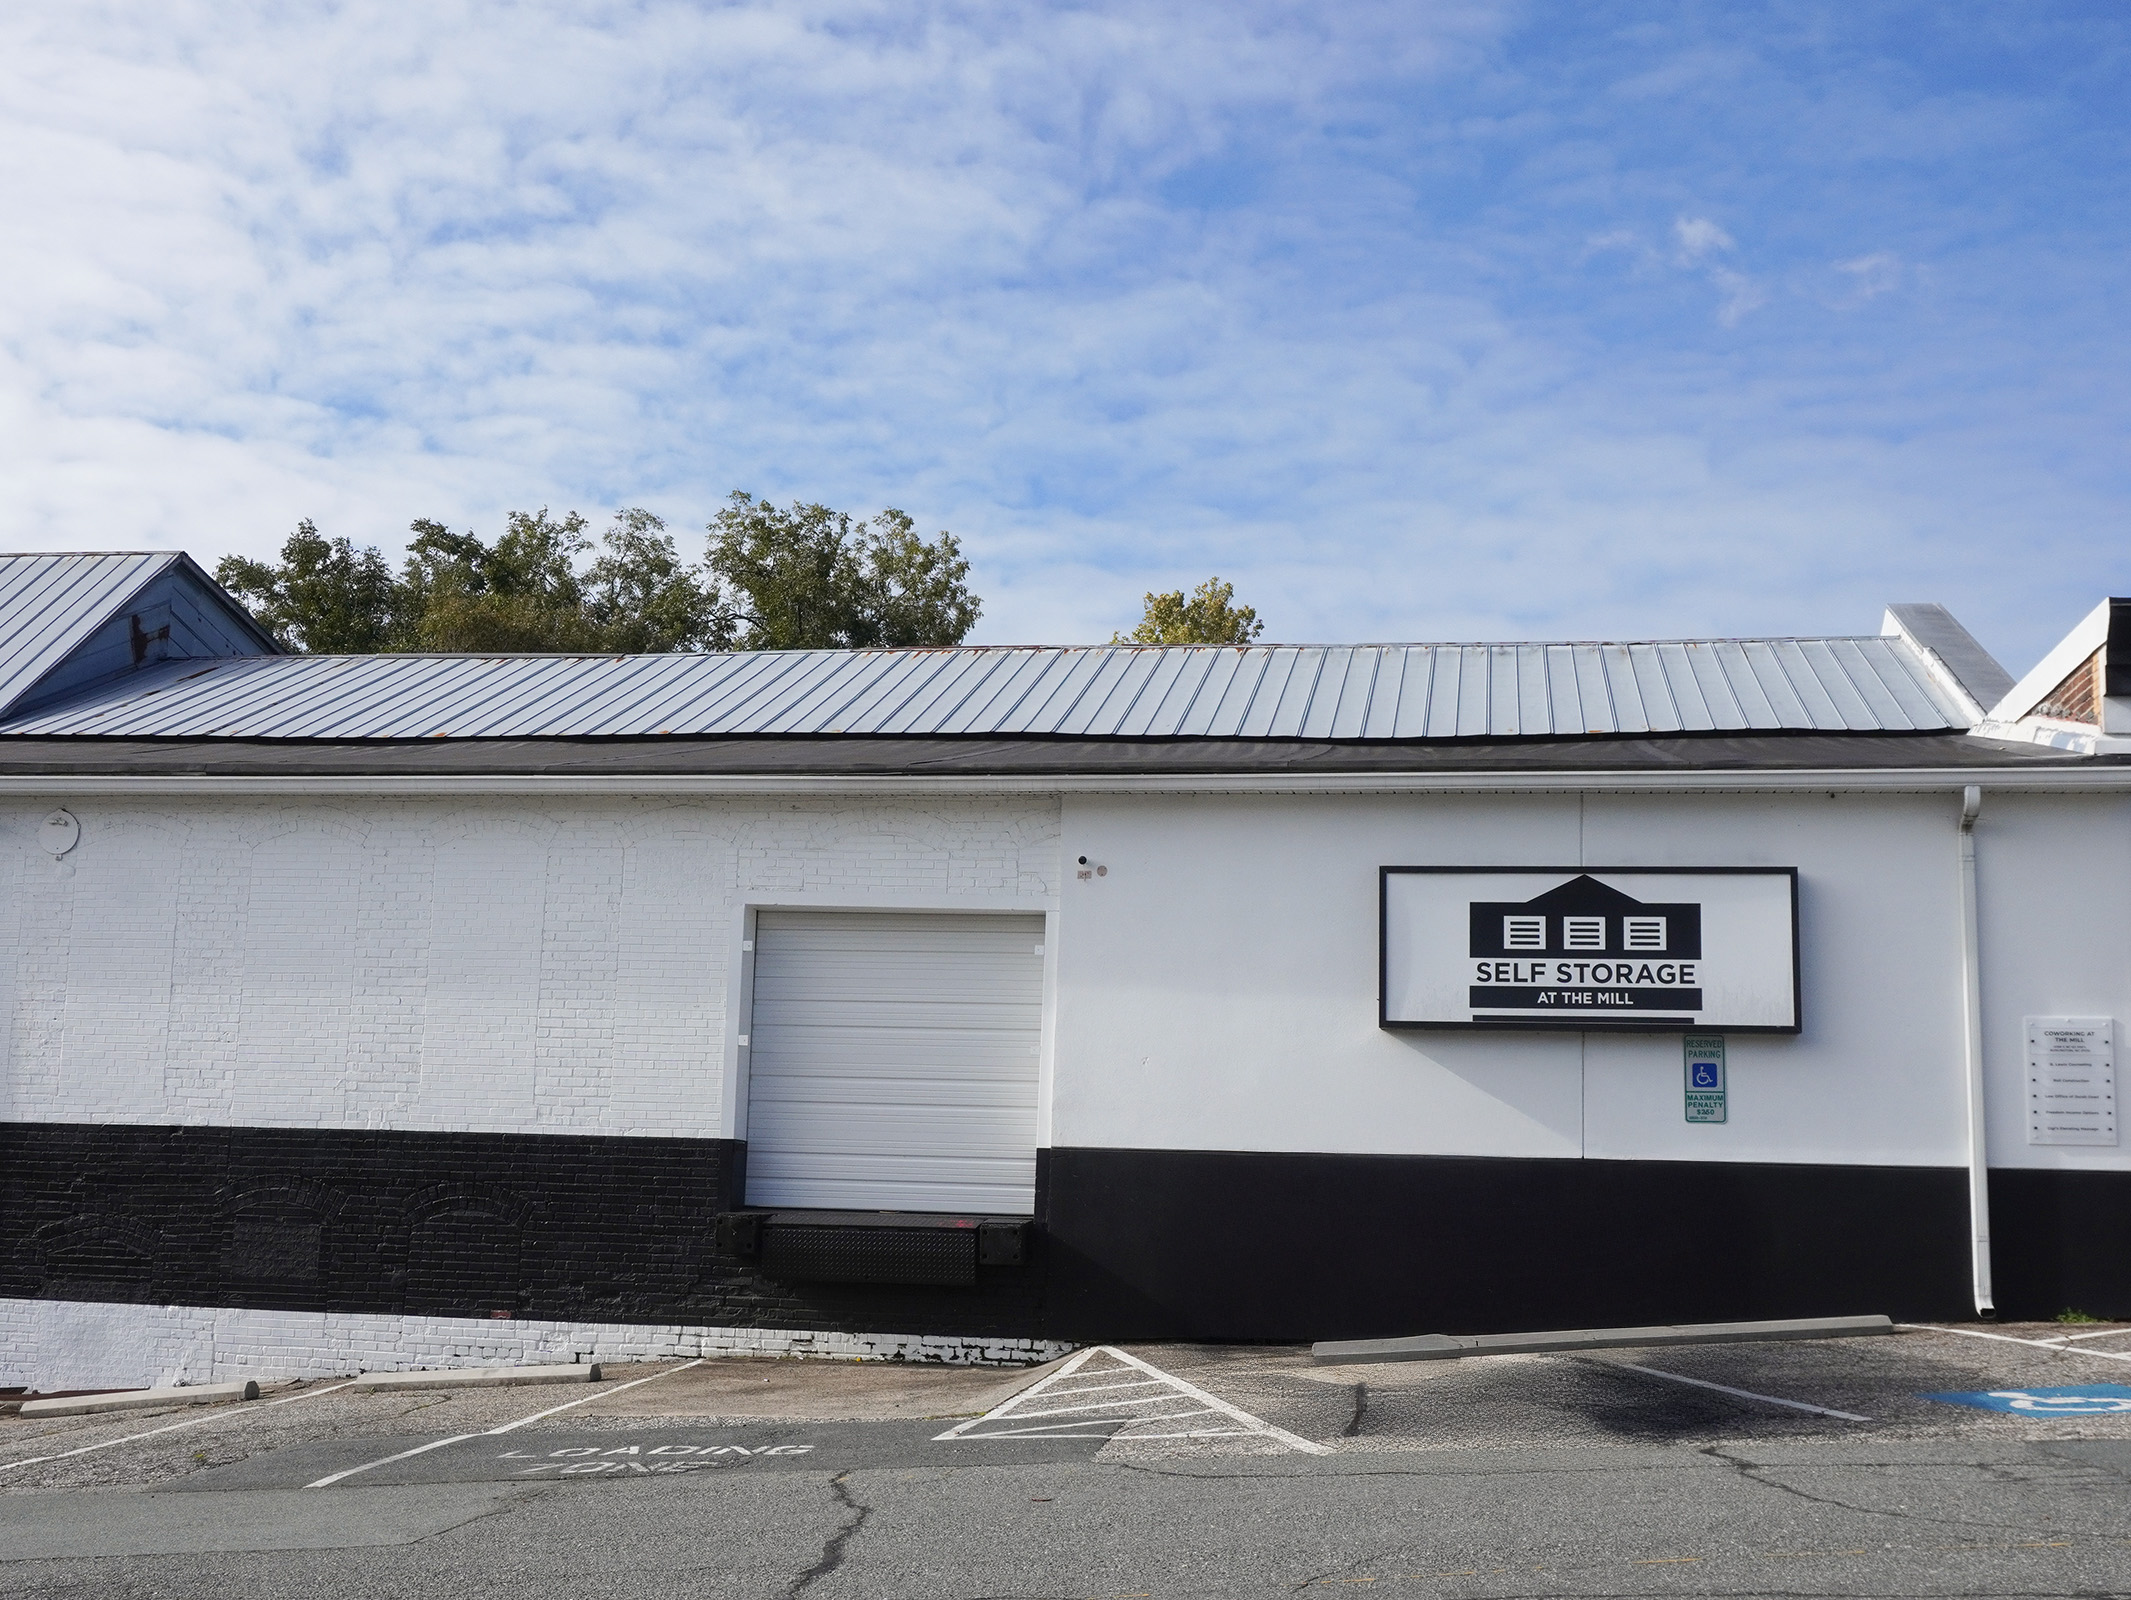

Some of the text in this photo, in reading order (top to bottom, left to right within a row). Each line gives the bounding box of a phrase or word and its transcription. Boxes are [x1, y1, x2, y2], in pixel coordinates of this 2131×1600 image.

[1476, 962, 1695, 984] SELF STORAGE
[1537, 992, 1634, 1005] AT THE MILL
[1686, 1040, 1722, 1048] RESERVED
[1688, 1050, 1721, 1059] PARKING
[497, 1445, 815, 1459] LOADING
[511, 1461, 720, 1475] ZONE
